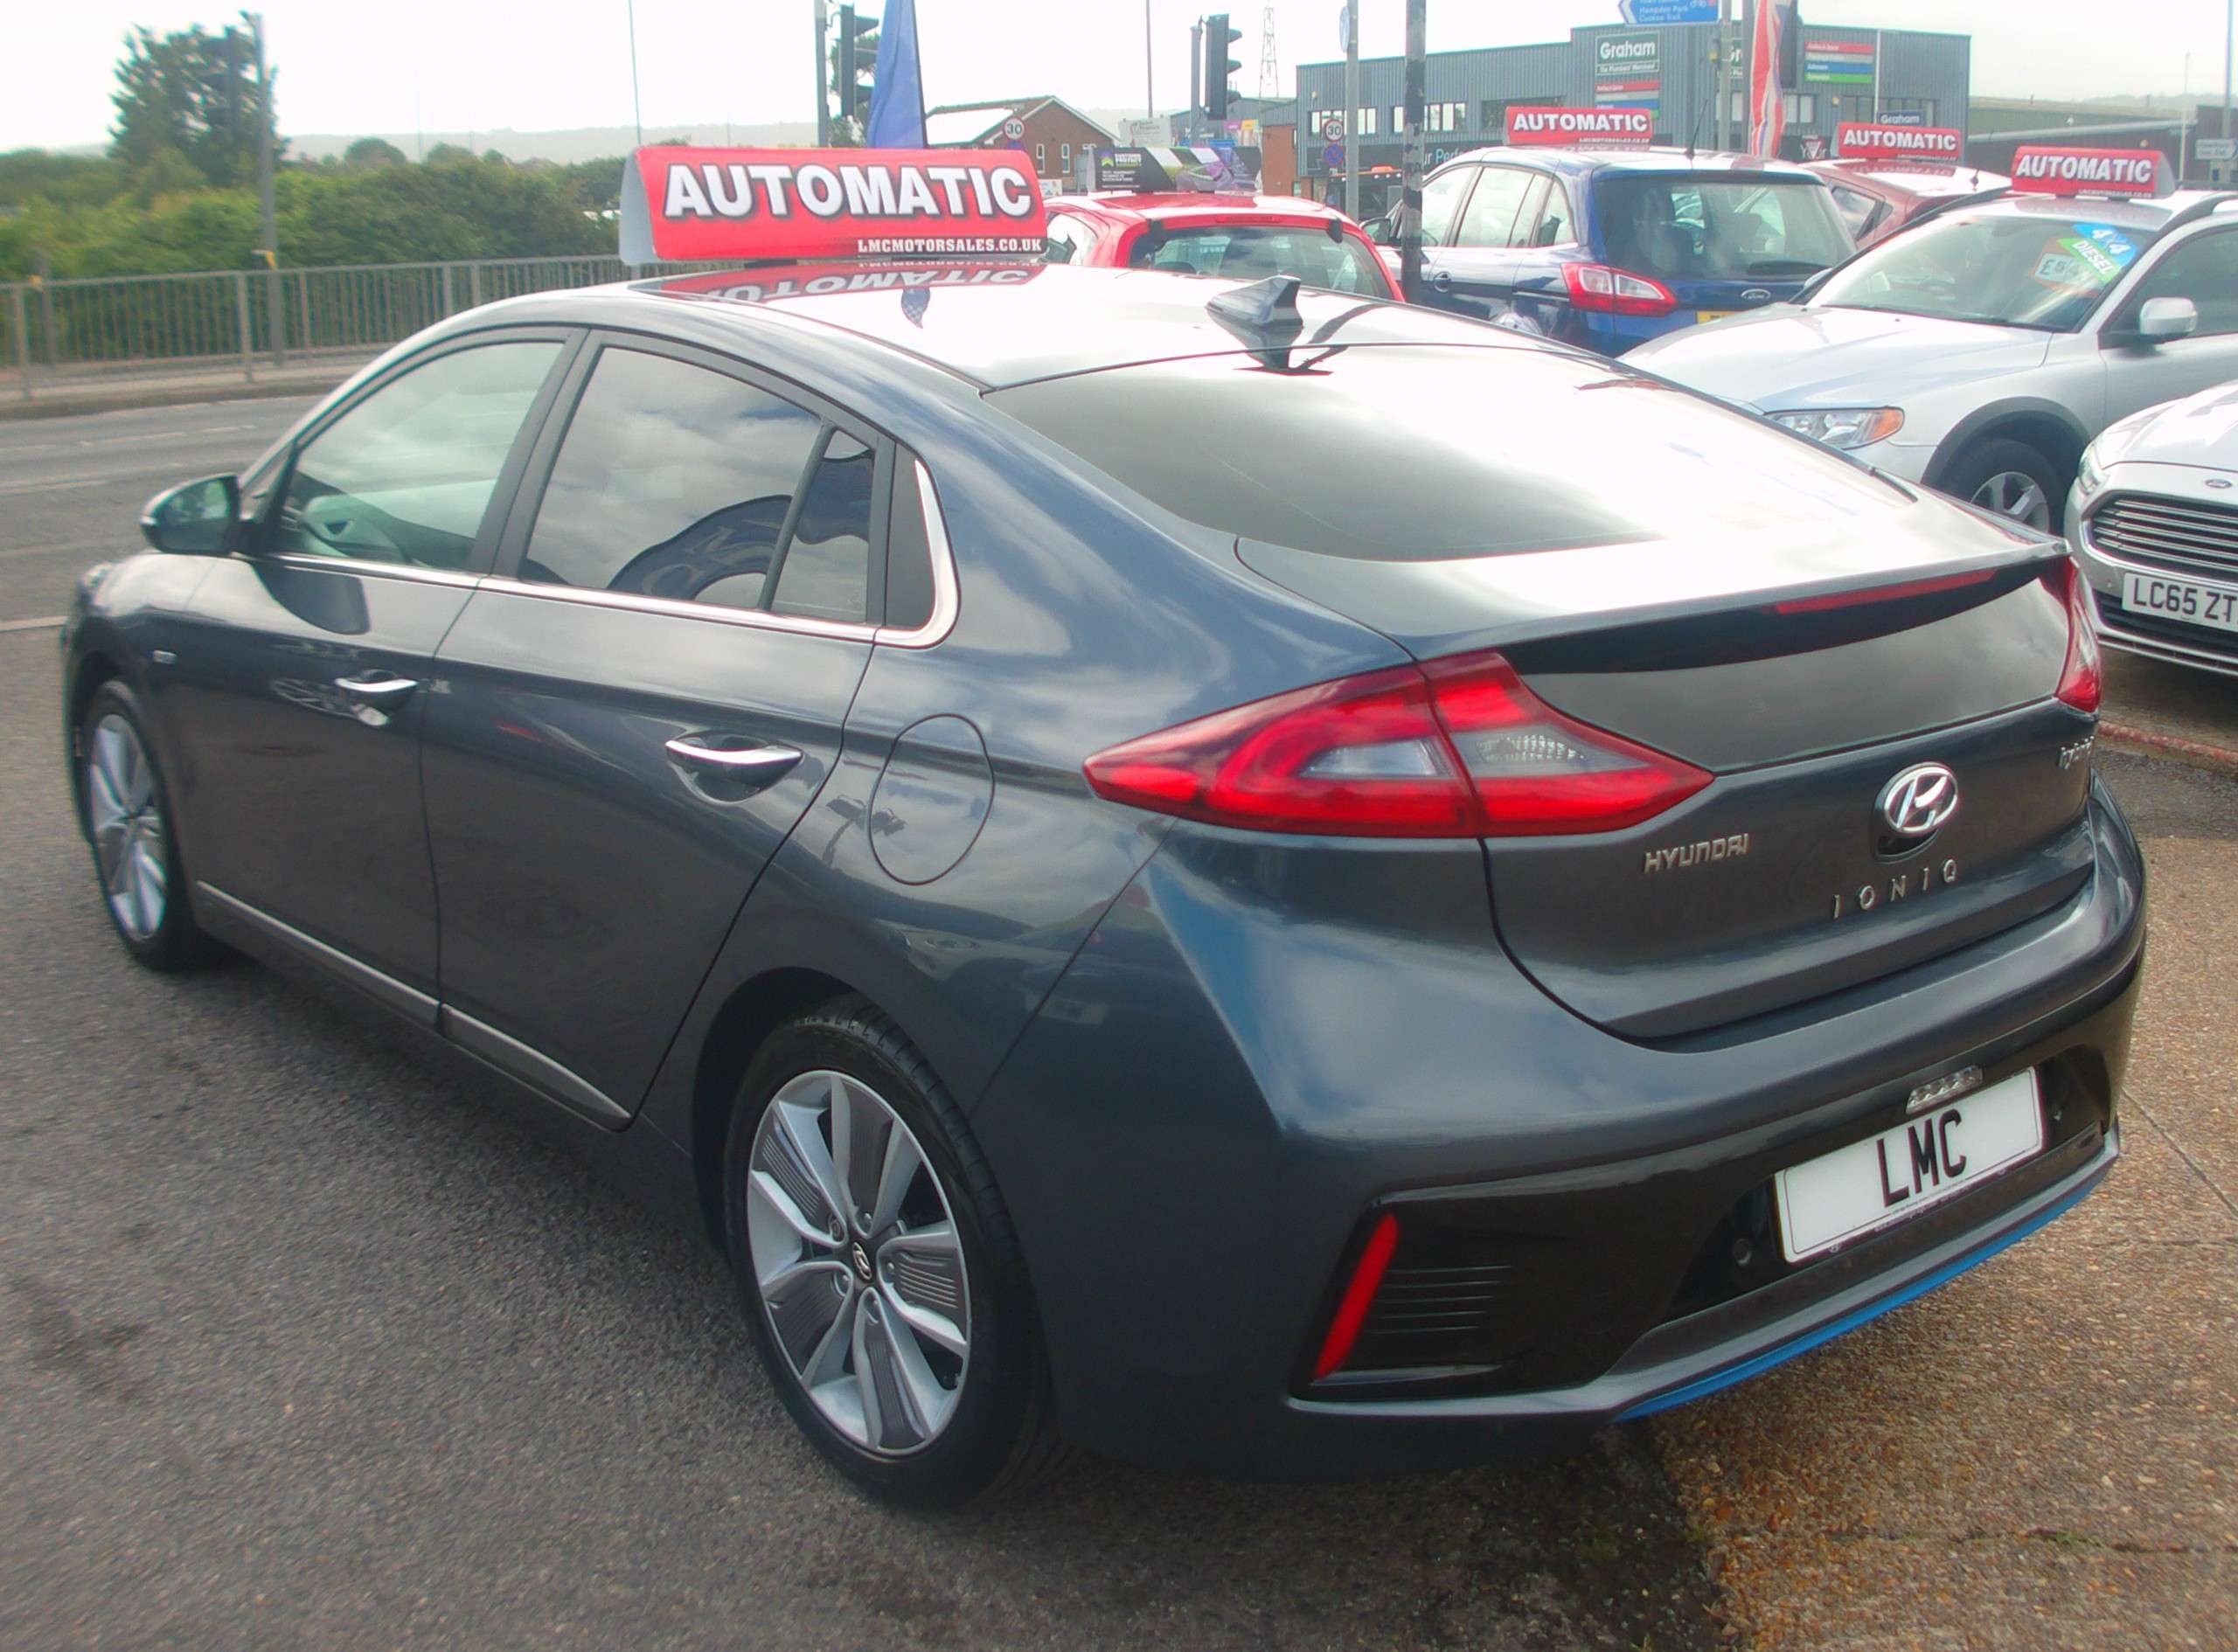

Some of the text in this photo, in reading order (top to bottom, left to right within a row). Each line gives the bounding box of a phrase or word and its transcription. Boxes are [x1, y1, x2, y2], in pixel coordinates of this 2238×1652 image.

[1600, 40, 1655, 59] Graham
[1006, 123, 1023, 135] 30
[1328, 125, 1340, 135] 30
[1513, 114, 1648, 132] AUTOMATIC
[1880, 114, 1920, 124] Graham
[1843, 129, 1957, 150] AUTOMATIC
[2015, 155, 2152, 184] AUTOMATIC
[664, 163, 1032, 218] AUTOMATIC
[857, 238, 1042, 255] LMCMOTORSALES.CO.UK
[2072, 239, 2114, 274] DIESEL
[2133, 578, 2238, 623] LC65 ZT
[1644, 833, 1749, 873] HYUNDAI
[1832, 858, 1958, 920] IONIQ
[1876, 1108, 1967, 1208] LMC
